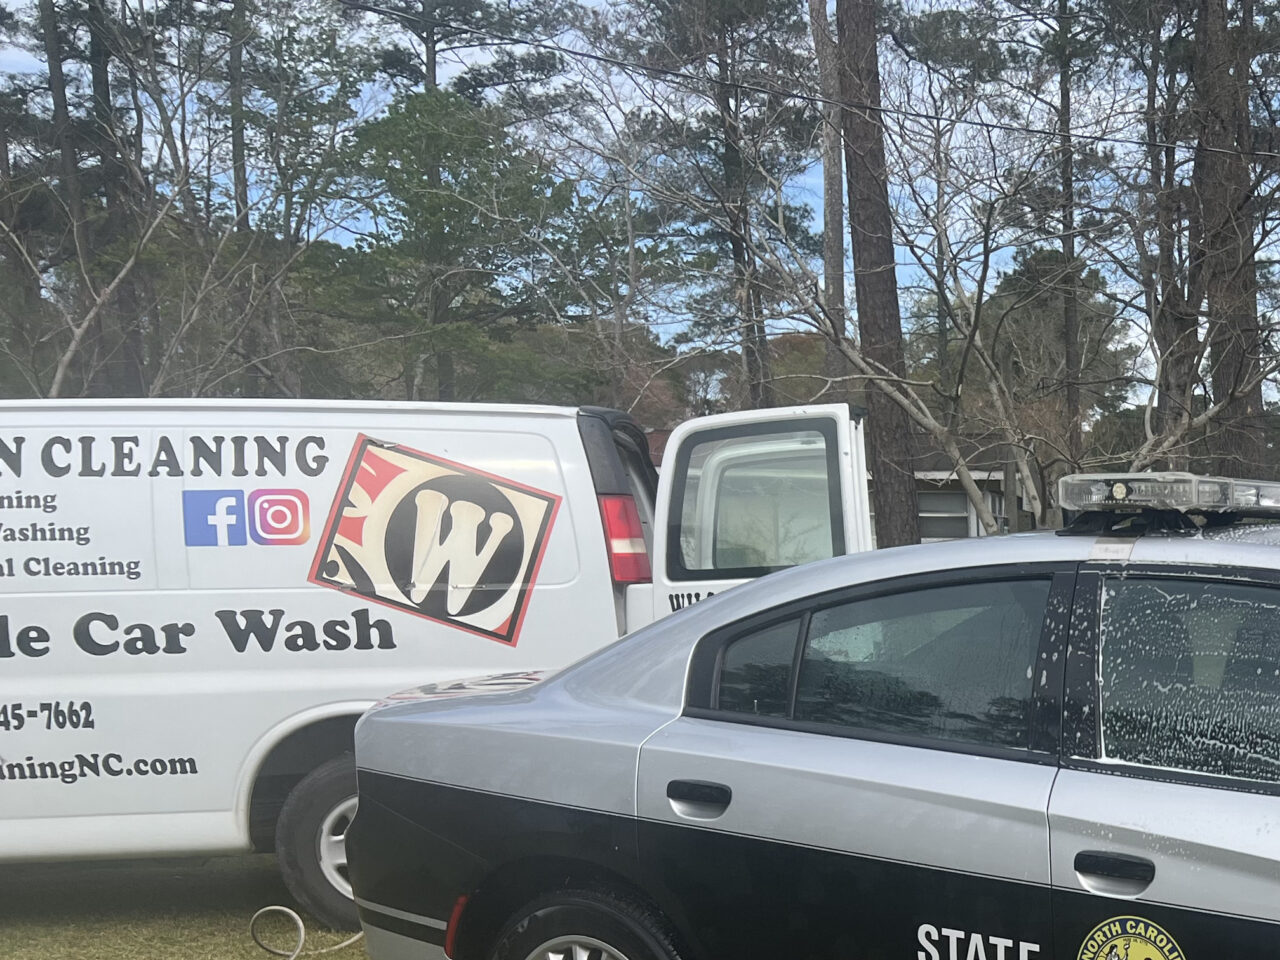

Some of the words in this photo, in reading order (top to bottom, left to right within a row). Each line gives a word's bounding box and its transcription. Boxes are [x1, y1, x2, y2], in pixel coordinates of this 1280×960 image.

[41, 435, 329, 478] CLEANING
[0, 522, 90, 546] ashing
[23, 556, 141, 580] Cleaning
[73, 611, 196, 656] Car
[215, 609, 397, 653] Wash
[0, 701, 95, 731] 45-7662
